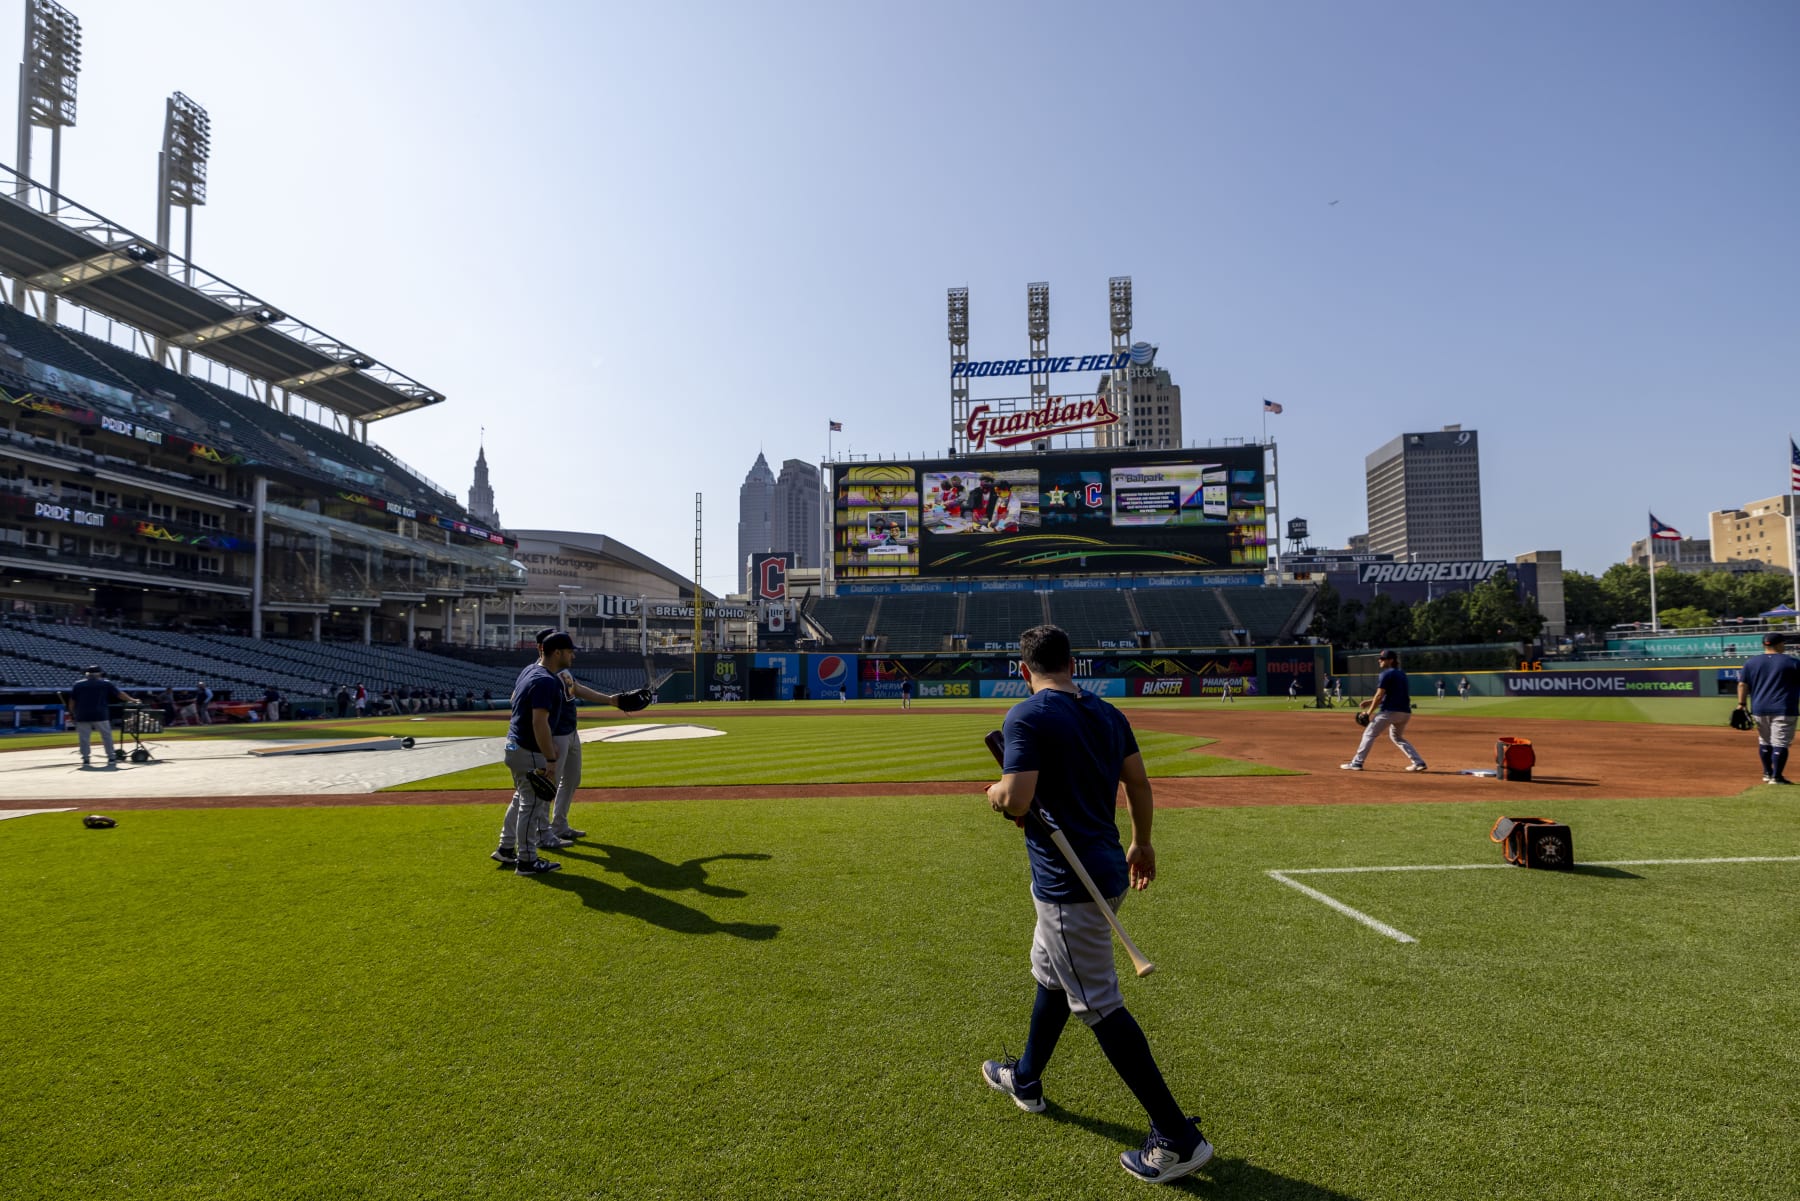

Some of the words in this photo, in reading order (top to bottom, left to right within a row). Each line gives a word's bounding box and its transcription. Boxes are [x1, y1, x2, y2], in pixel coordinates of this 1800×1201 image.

[951, 357, 1072, 378] PROGRESSIVE
[1077, 352, 1130, 371] FIELD
[102, 415, 133, 437] PRIDE
[966, 397, 1120, 450] Guardians
[1126, 473, 1164, 483] Ballpark
[35, 502, 70, 521] PRIDE
[74, 510, 104, 527] NIGHT
[515, 553, 547, 564] CKET
[527, 568, 578, 577] IELDHOUSE
[596, 594, 639, 618] Lite
[705, 608, 716, 617] IN
[719, 608, 744, 618] OHIO
[716, 662, 735, 675] 811
[1267, 661, 1313, 674] meijer
[920, 683, 970, 696] bet365
[1142, 681, 1182, 695] BLASTER
[1626, 681, 1693, 691] MORTGAGE
